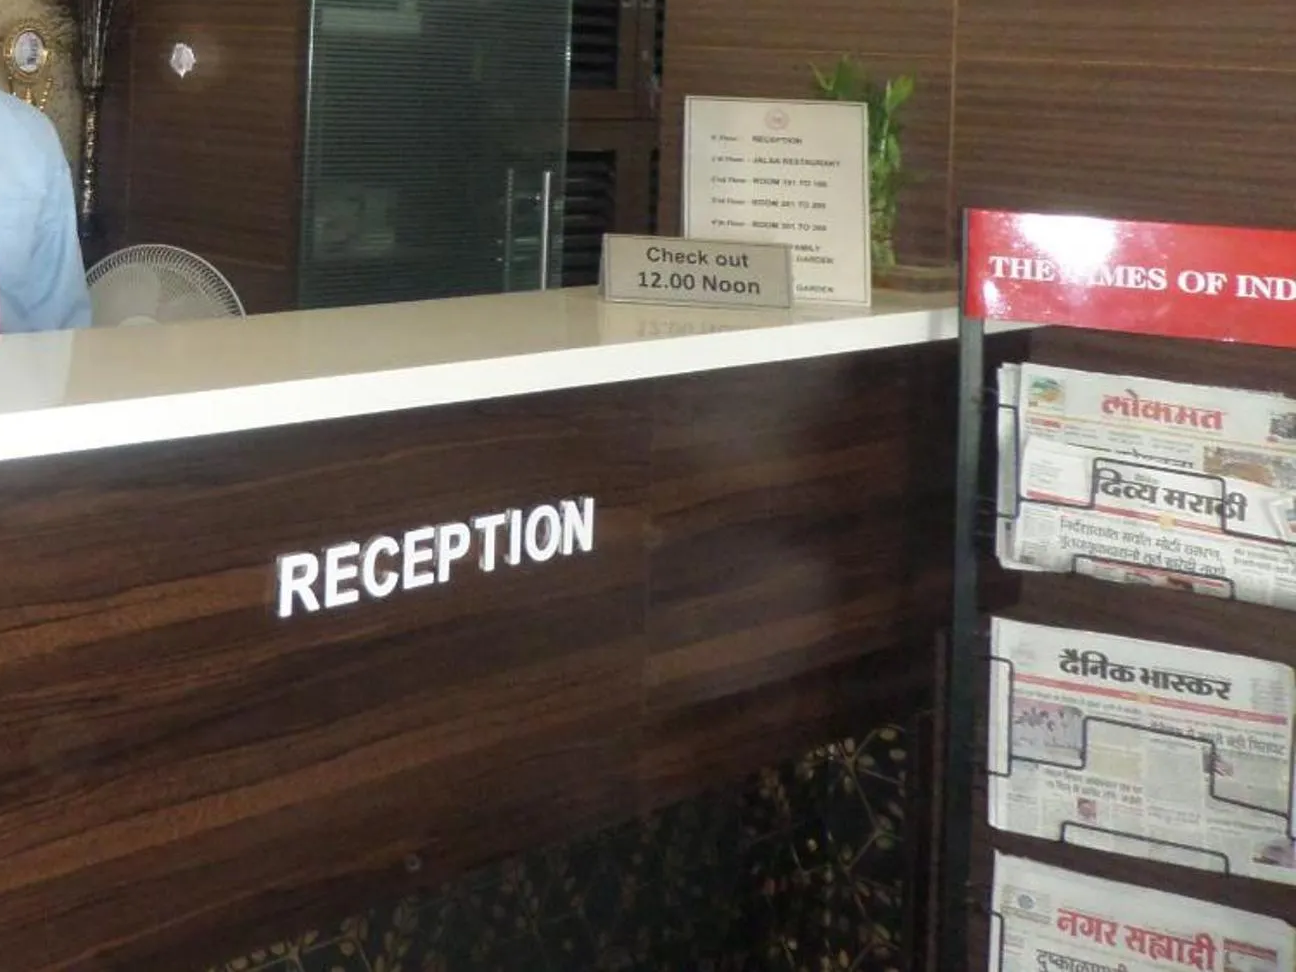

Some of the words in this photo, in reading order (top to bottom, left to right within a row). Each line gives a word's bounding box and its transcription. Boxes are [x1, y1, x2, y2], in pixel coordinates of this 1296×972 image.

[752, 135, 803, 145] RECEPTION
[646, 246, 709, 265] Check
[714, 253, 750, 269] out
[988, 255, 1056, 282] THE
[1060, 262, 1168, 291] MES
[1176, 269, 1228, 296] OF
[637, 271, 696, 291] 12.00
[701, 274, 762, 295] Noon
[1101, 388, 1226, 430] लोकमत
[276, 496, 595, 619] RECEPTION
[1058, 648, 1136, 683] दैनिक
[1138, 666, 1233, 701] भास्कर
[1057, 908, 1120, 948] नगर
